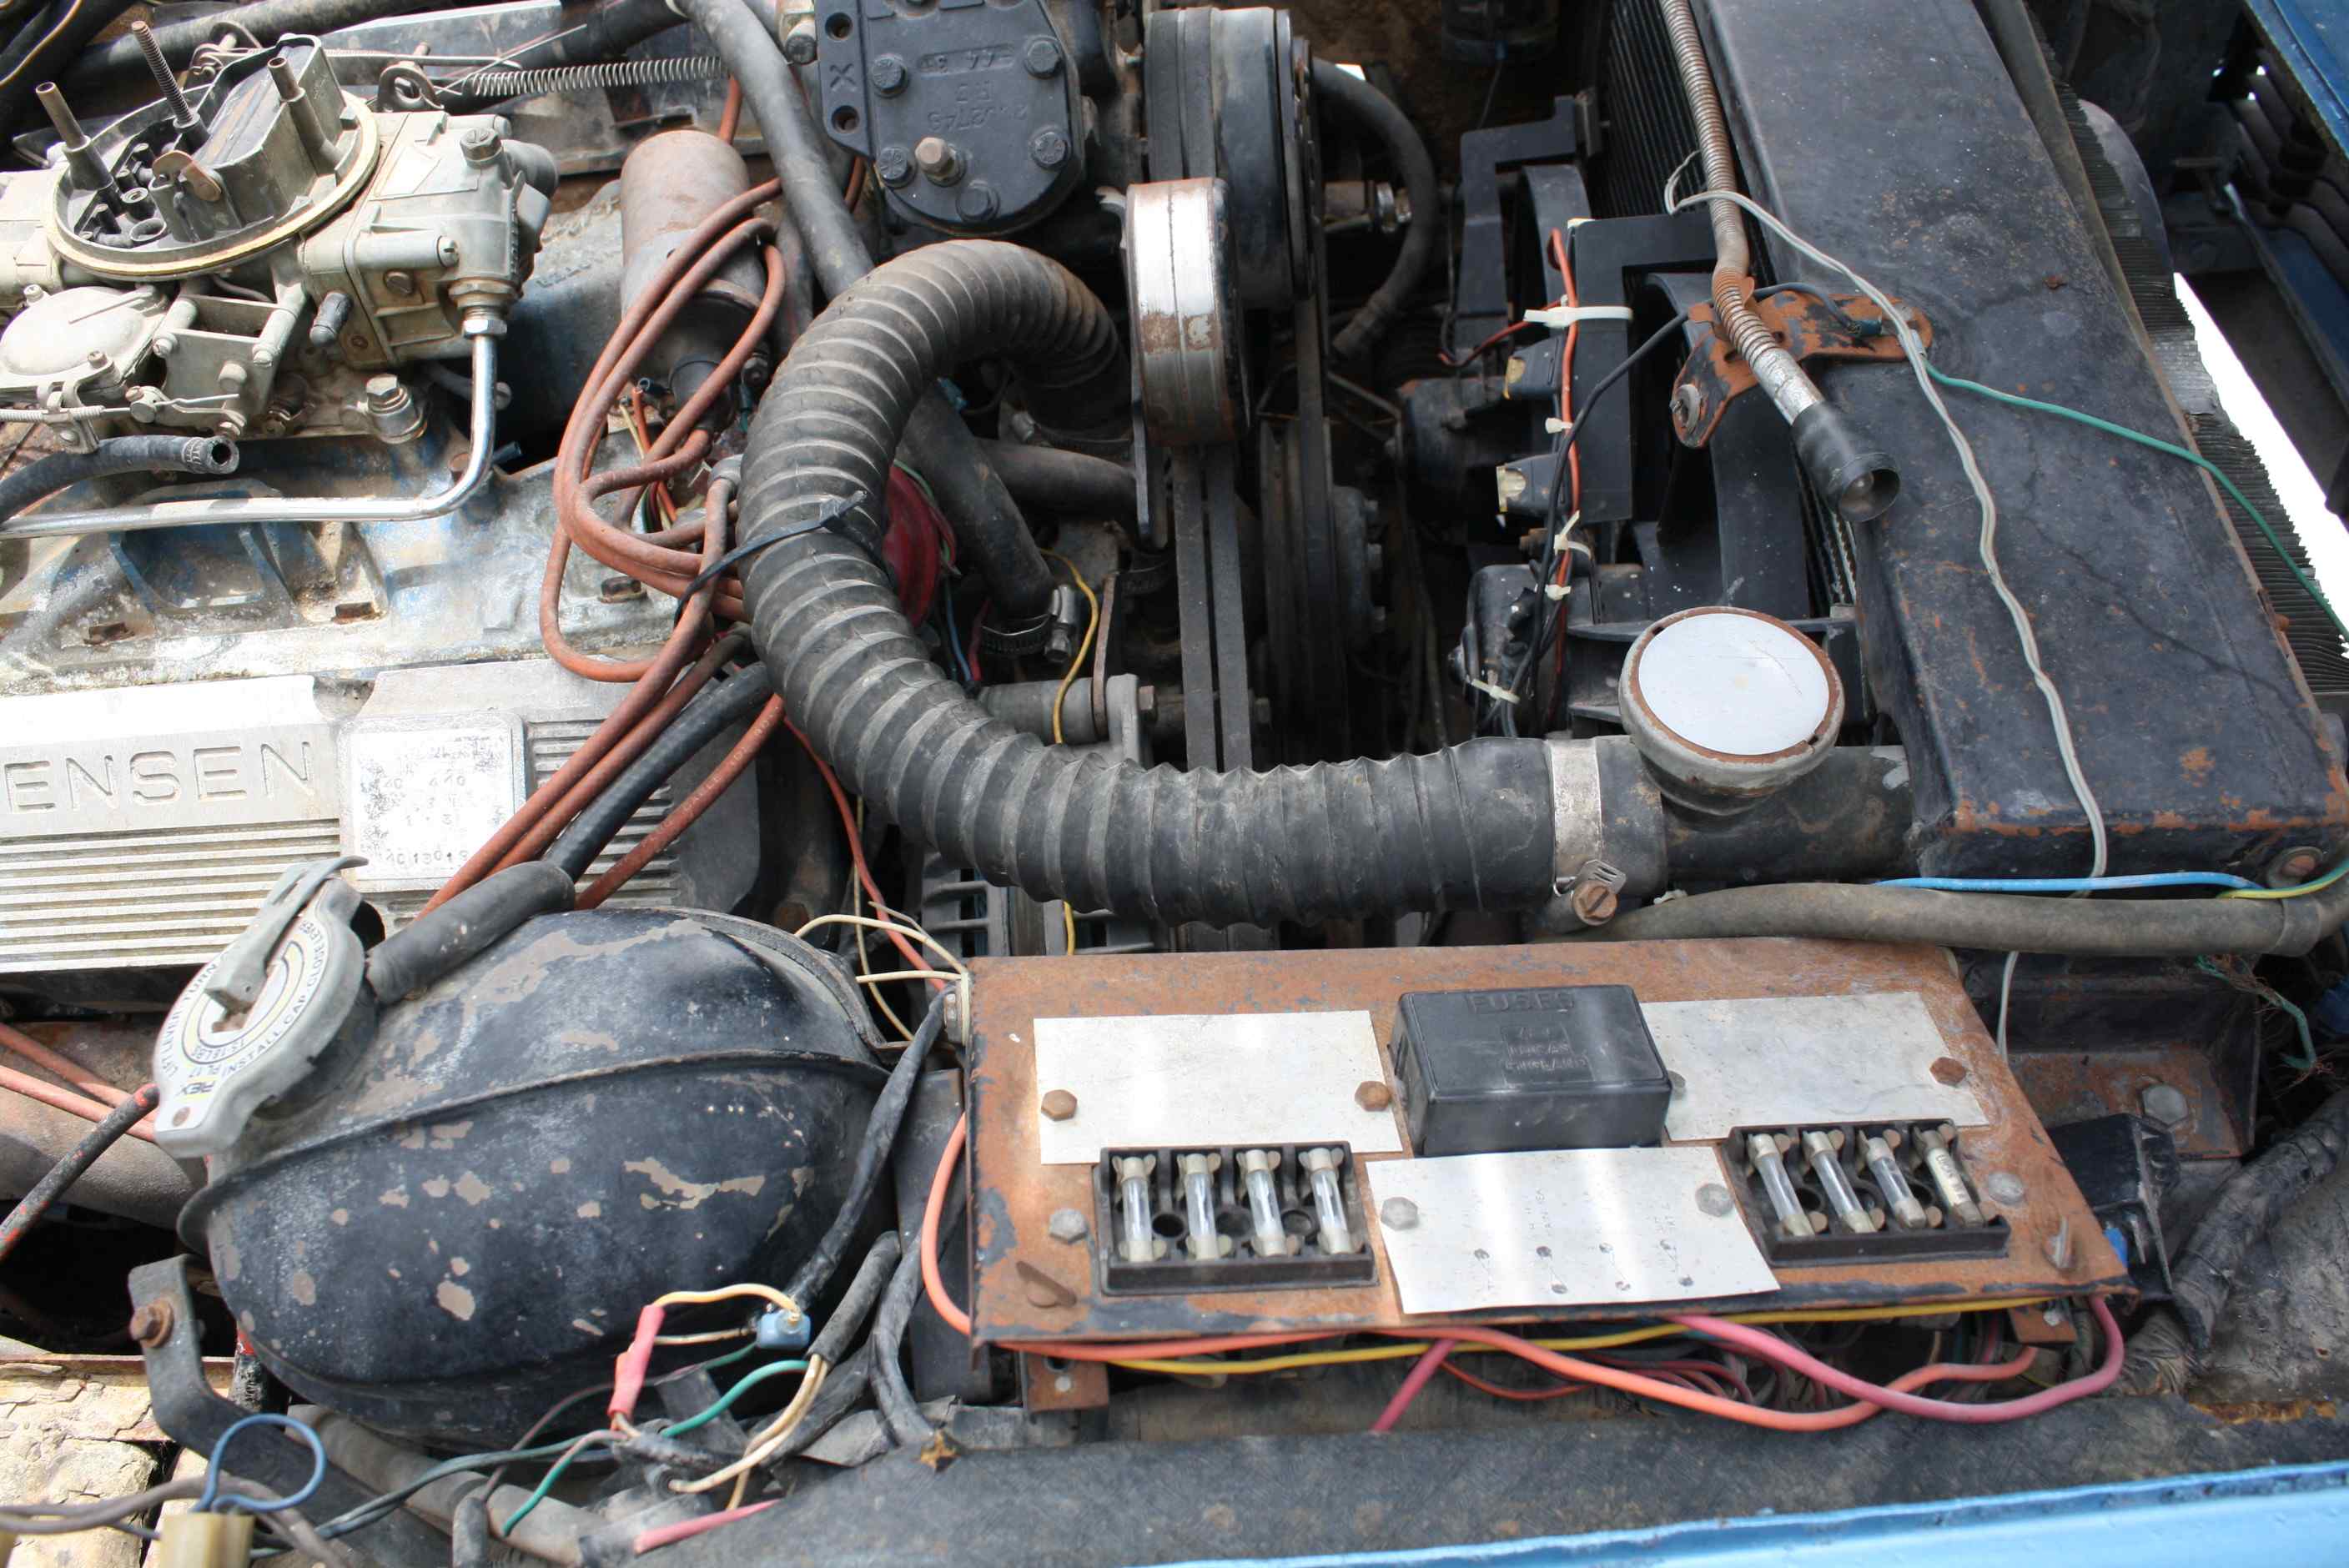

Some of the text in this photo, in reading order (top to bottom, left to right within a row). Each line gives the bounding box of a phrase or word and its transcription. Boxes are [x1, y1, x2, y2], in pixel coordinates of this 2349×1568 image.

[4, 741, 316, 813] ENSEN
[221, 1031, 281, 1078] INSTALL
[284, 995, 307, 1024] CAP
